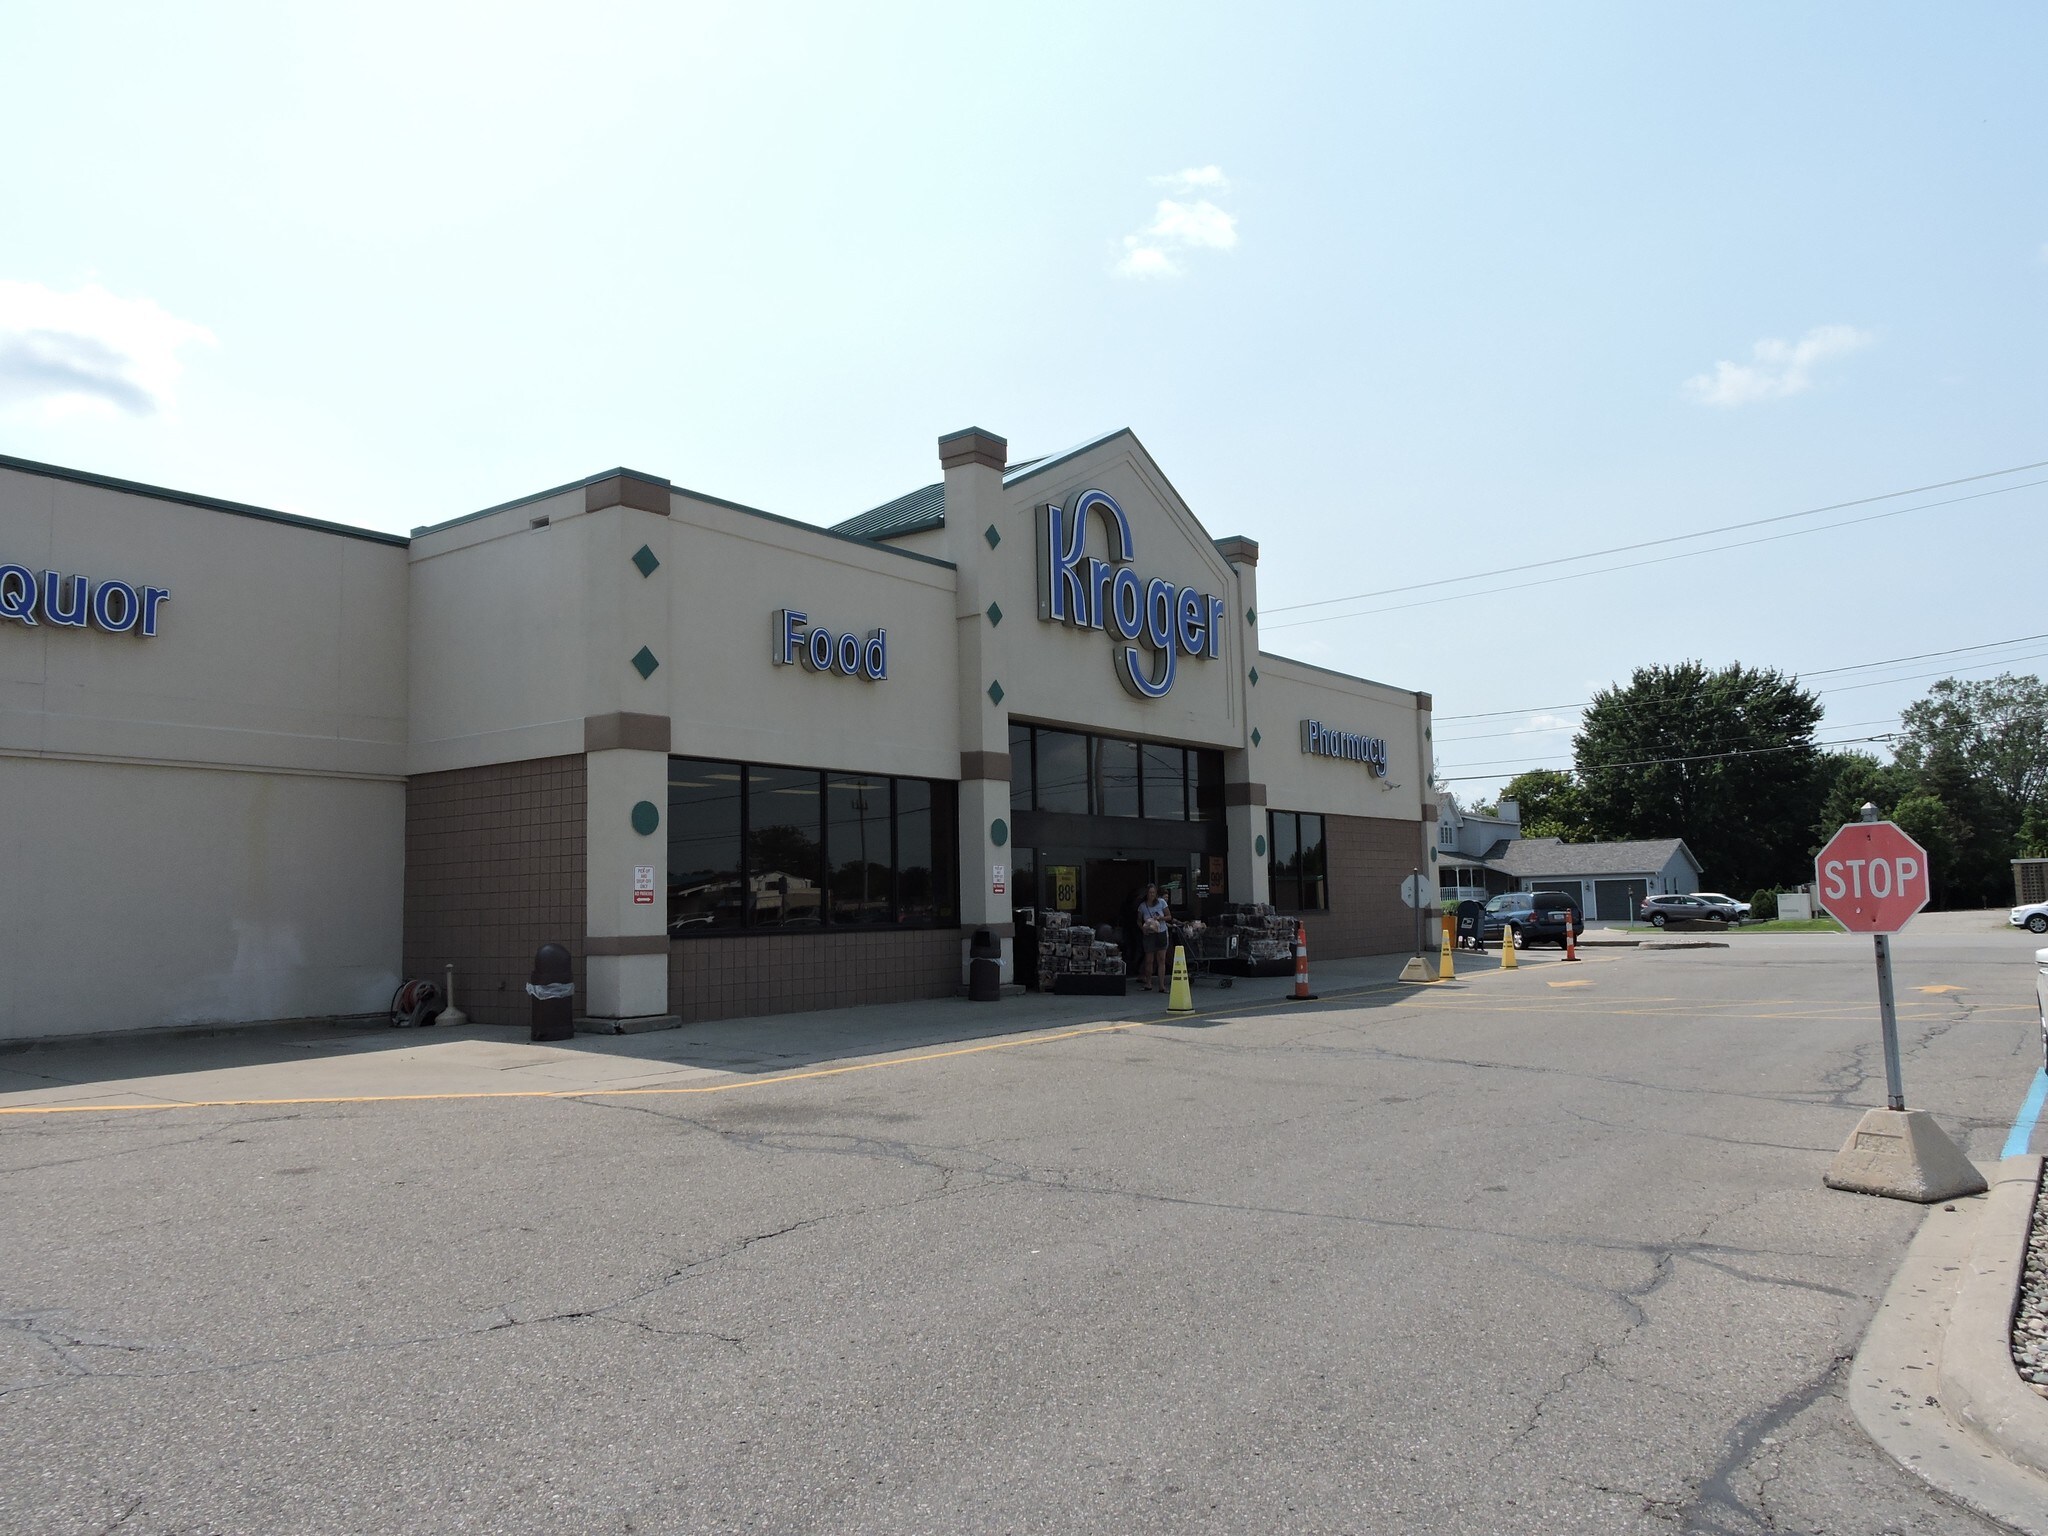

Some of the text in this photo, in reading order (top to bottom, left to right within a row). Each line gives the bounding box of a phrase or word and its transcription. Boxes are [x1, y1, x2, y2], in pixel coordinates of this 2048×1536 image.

[1037, 488, 1224, 698] Kroger
[774, 608, 887, 681] Food
[1302, 719, 1387, 778] Pharmacy
[1824, 857, 1918, 900] STOP
